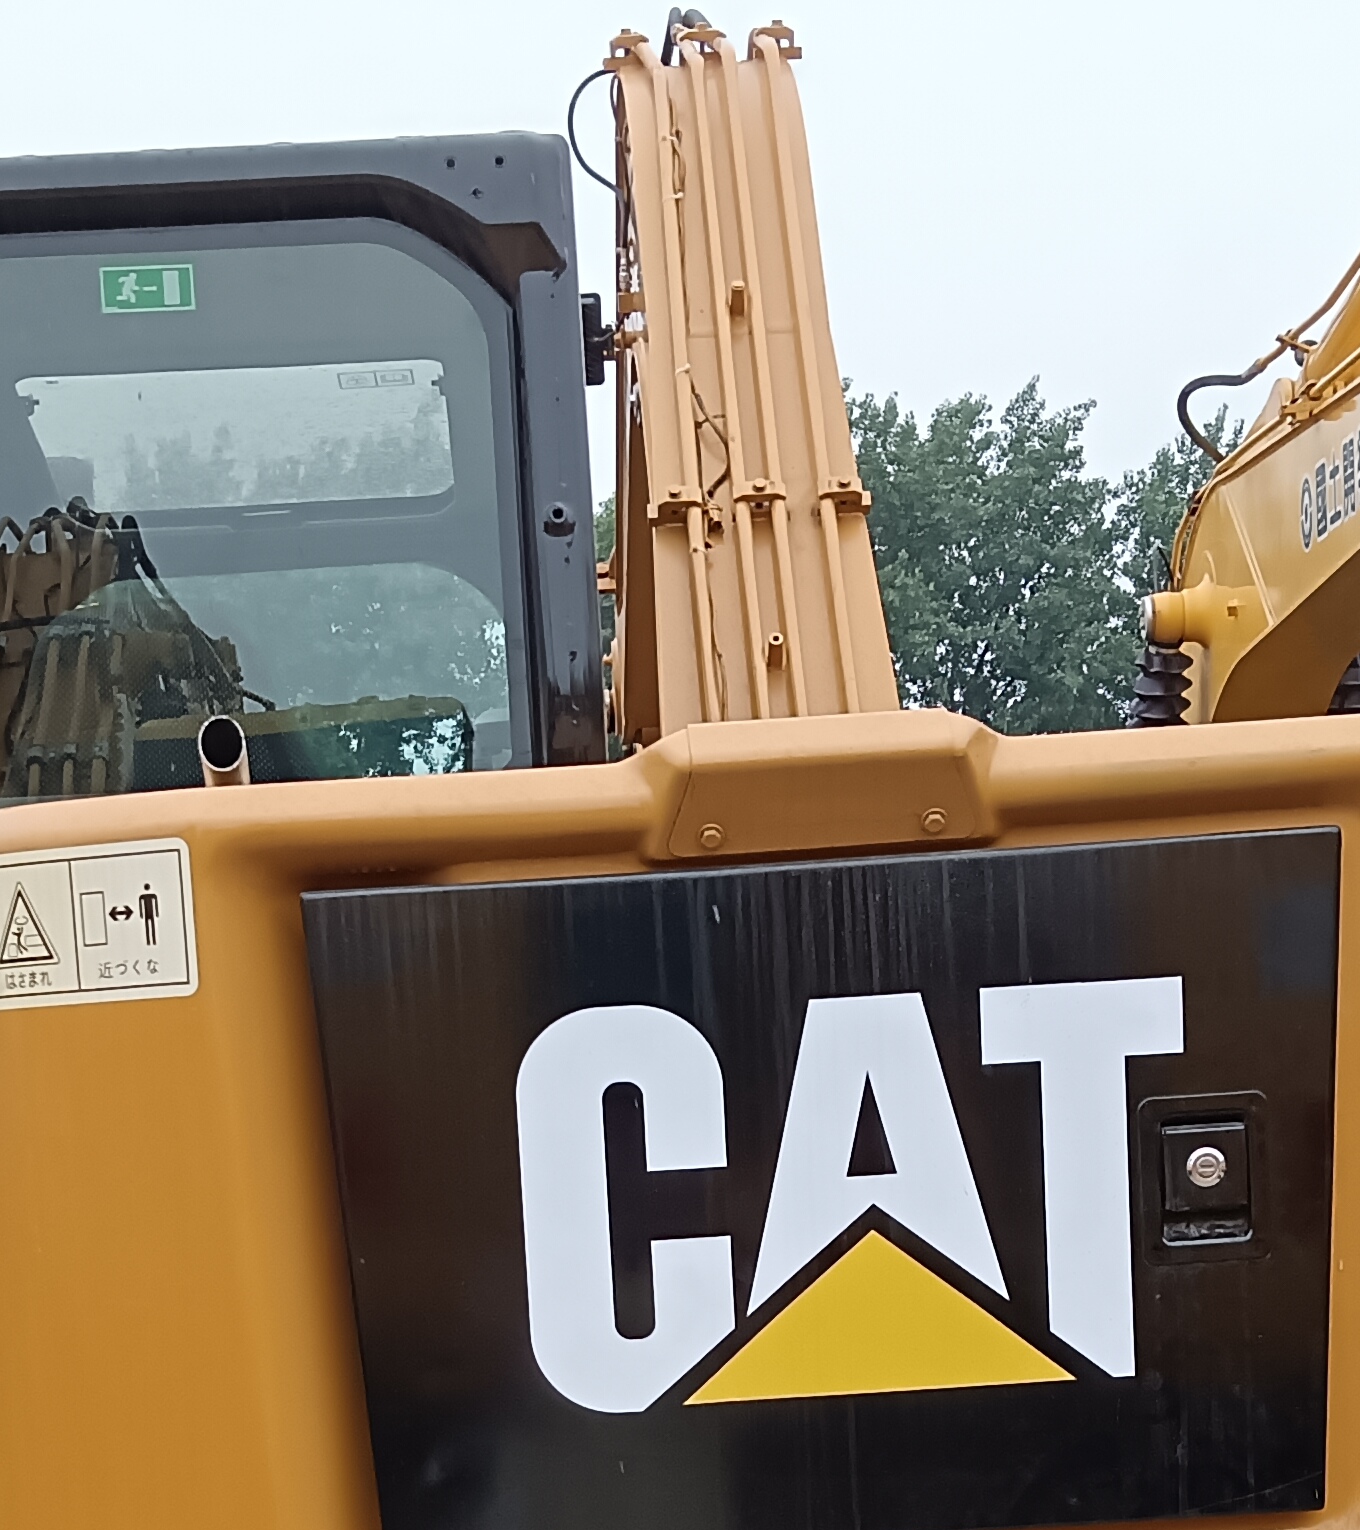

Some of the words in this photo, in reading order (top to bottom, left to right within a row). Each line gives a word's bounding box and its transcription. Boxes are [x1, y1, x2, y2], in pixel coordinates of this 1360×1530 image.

[98, 958, 160, 980] 近づくな
[5, 971, 53, 990] はさまれ
[515, 975, 1184, 1414] CAT
